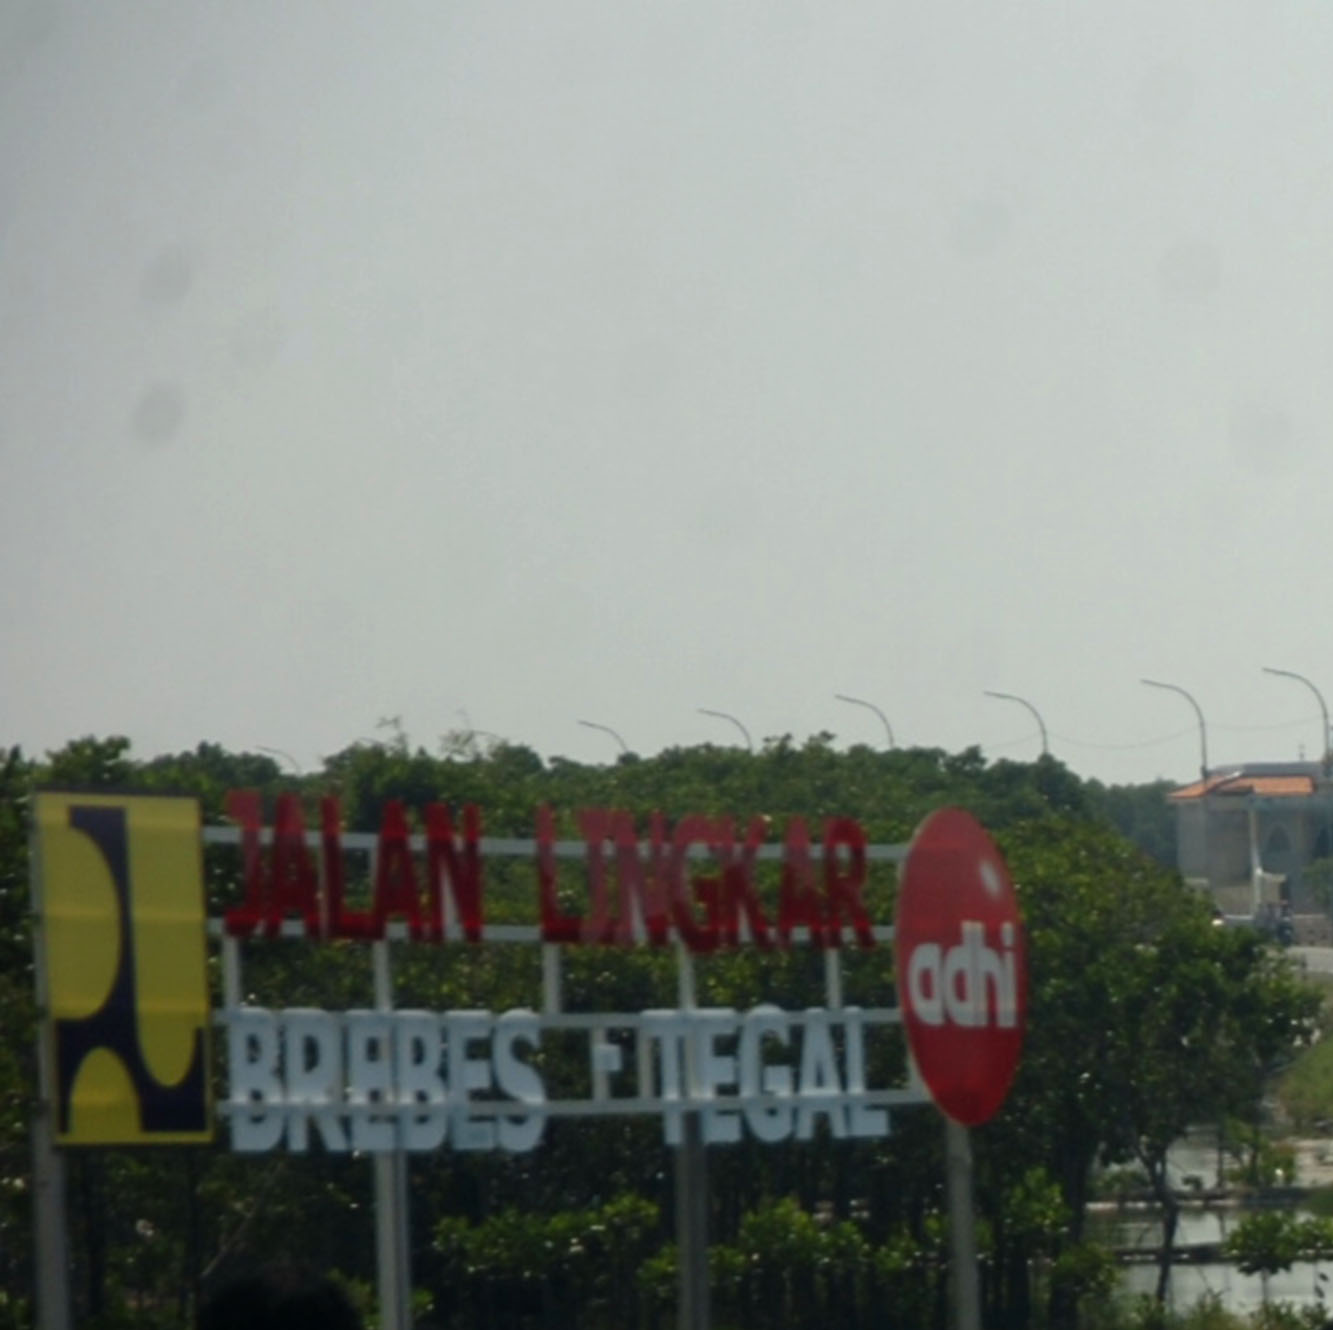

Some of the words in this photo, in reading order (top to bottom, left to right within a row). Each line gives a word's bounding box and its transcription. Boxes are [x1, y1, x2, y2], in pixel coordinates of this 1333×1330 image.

[225, 789, 483, 942] JALAN
[536, 801, 878, 955] LINGKAR
[908, 920, 1017, 1027] adhi
[228, 1006, 547, 1152] BREBES
[640, 1004, 890, 1146] TEGAL
